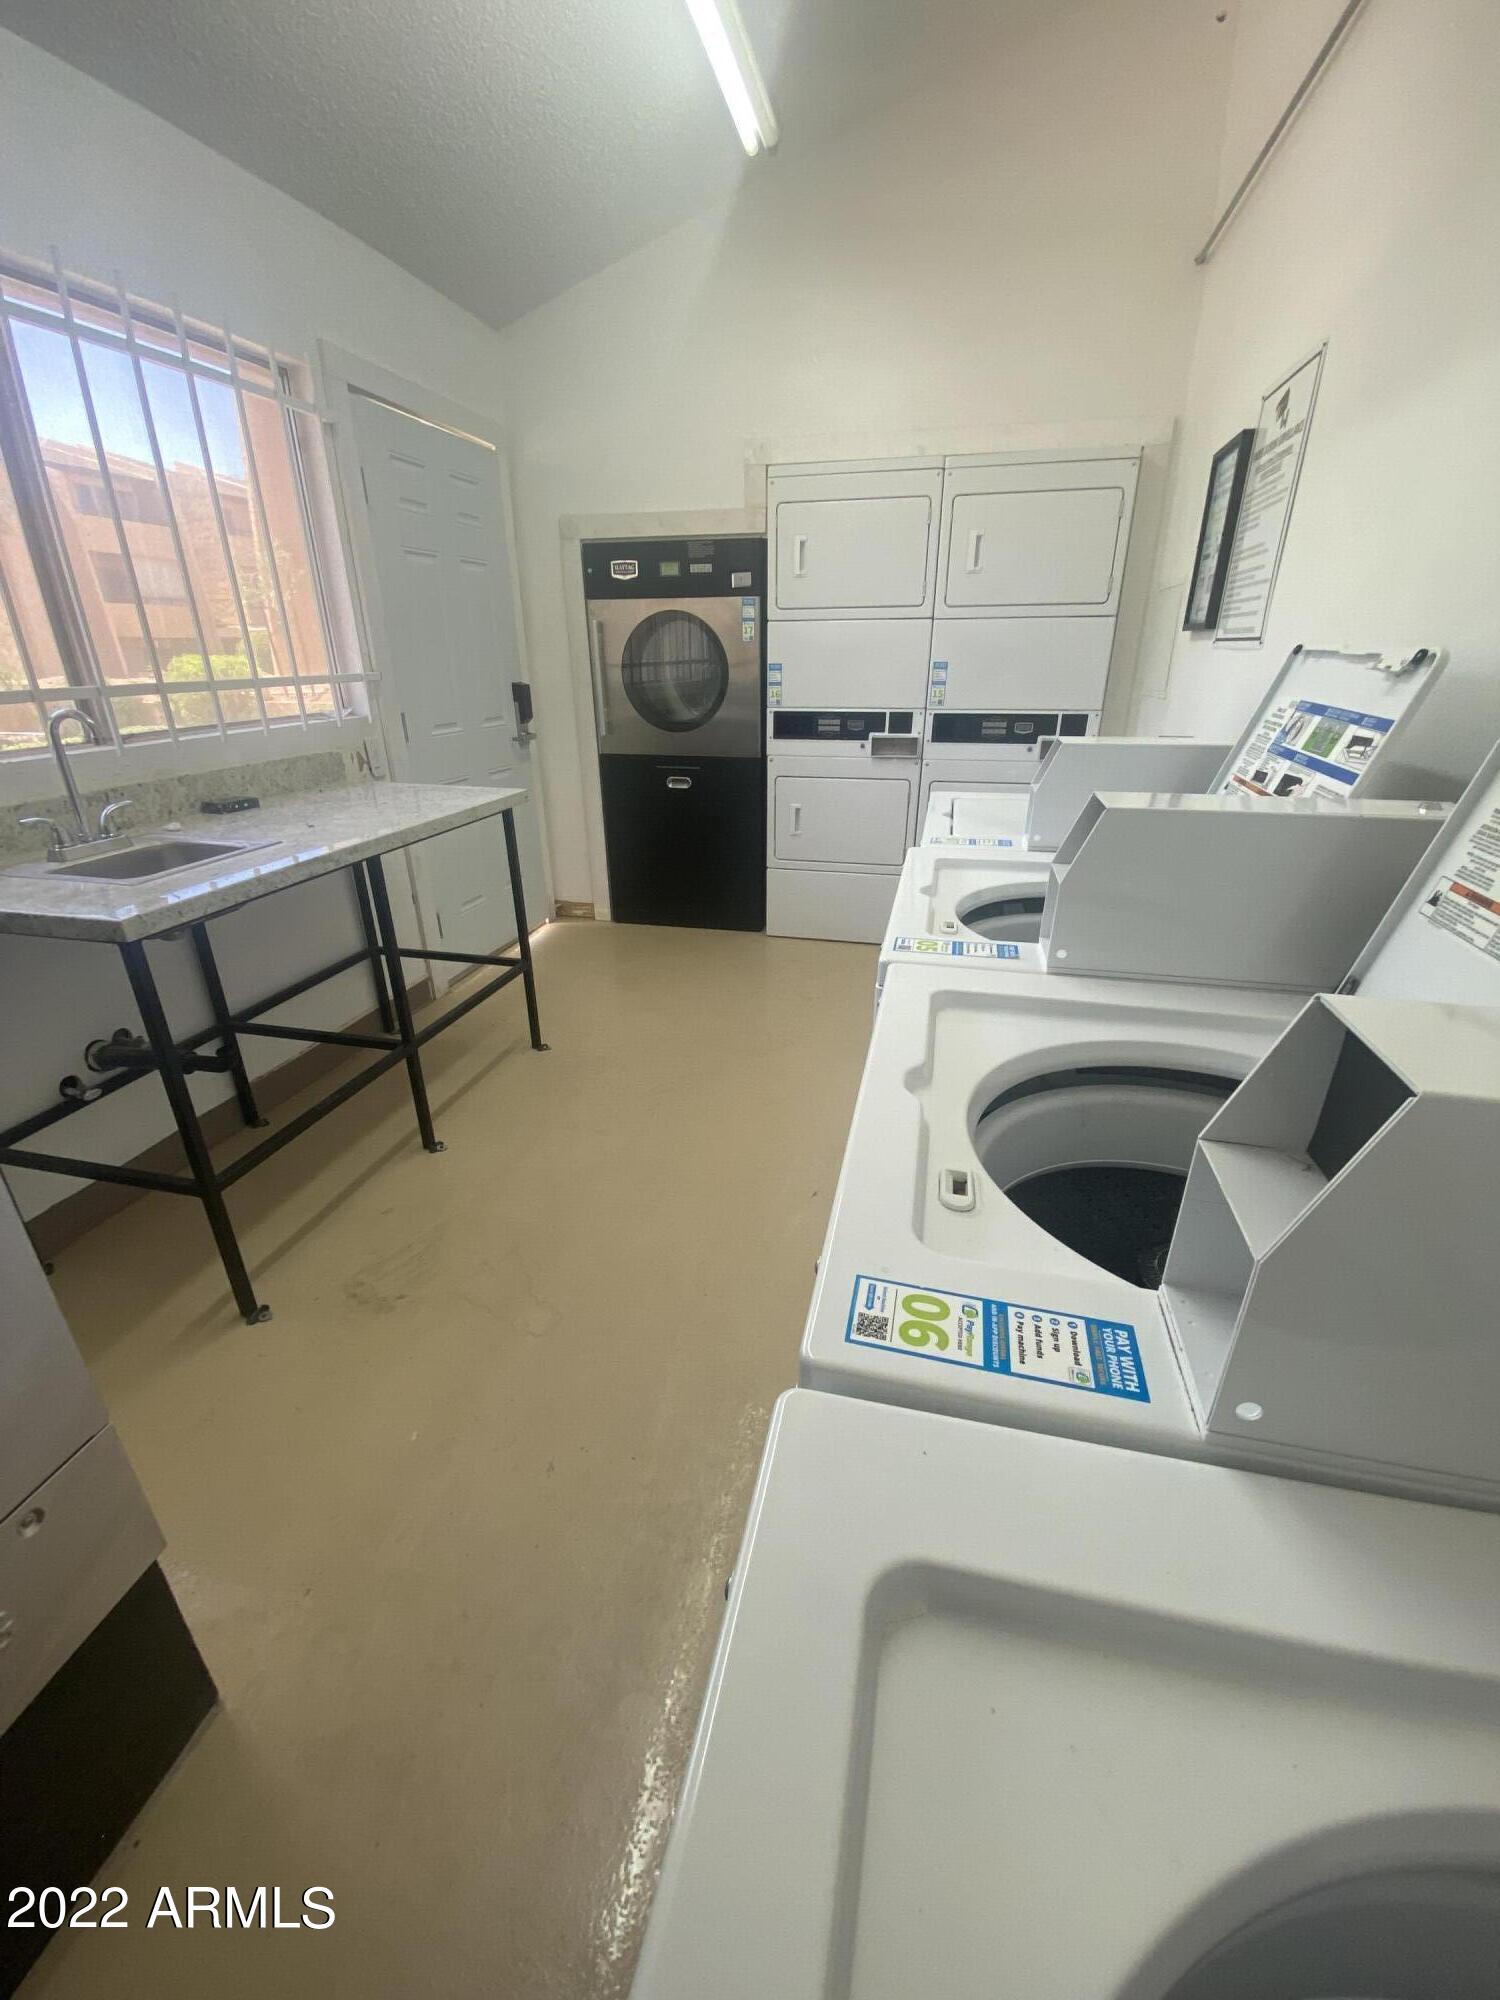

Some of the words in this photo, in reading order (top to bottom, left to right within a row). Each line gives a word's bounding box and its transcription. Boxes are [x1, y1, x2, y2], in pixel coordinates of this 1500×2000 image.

[744, 626, 753, 634] 17
[770, 689, 780, 698] 16
[932, 689, 943, 698] 15
[916, 940, 939, 952] 05
[899, 1294, 951, 1351] 06
[1015, 1321, 1024, 1333] Pay
[1034, 1324, 1042, 1337] Add
[1051, 1328, 1059, 1342] Sign
[1102, 1328, 1116, 1353] YOUR
[1115, 1330, 1132, 1355] PAY
[1018, 1334, 1026, 1364] machine
[1036, 1339, 1044, 1358] funds
[1053, 1344, 1061, 1352] up
[1071, 1331, 1082, 1366] Download
[1107, 1355, 1123, 1389] PHONE
[1122, 1357, 1140, 1392] WITH
